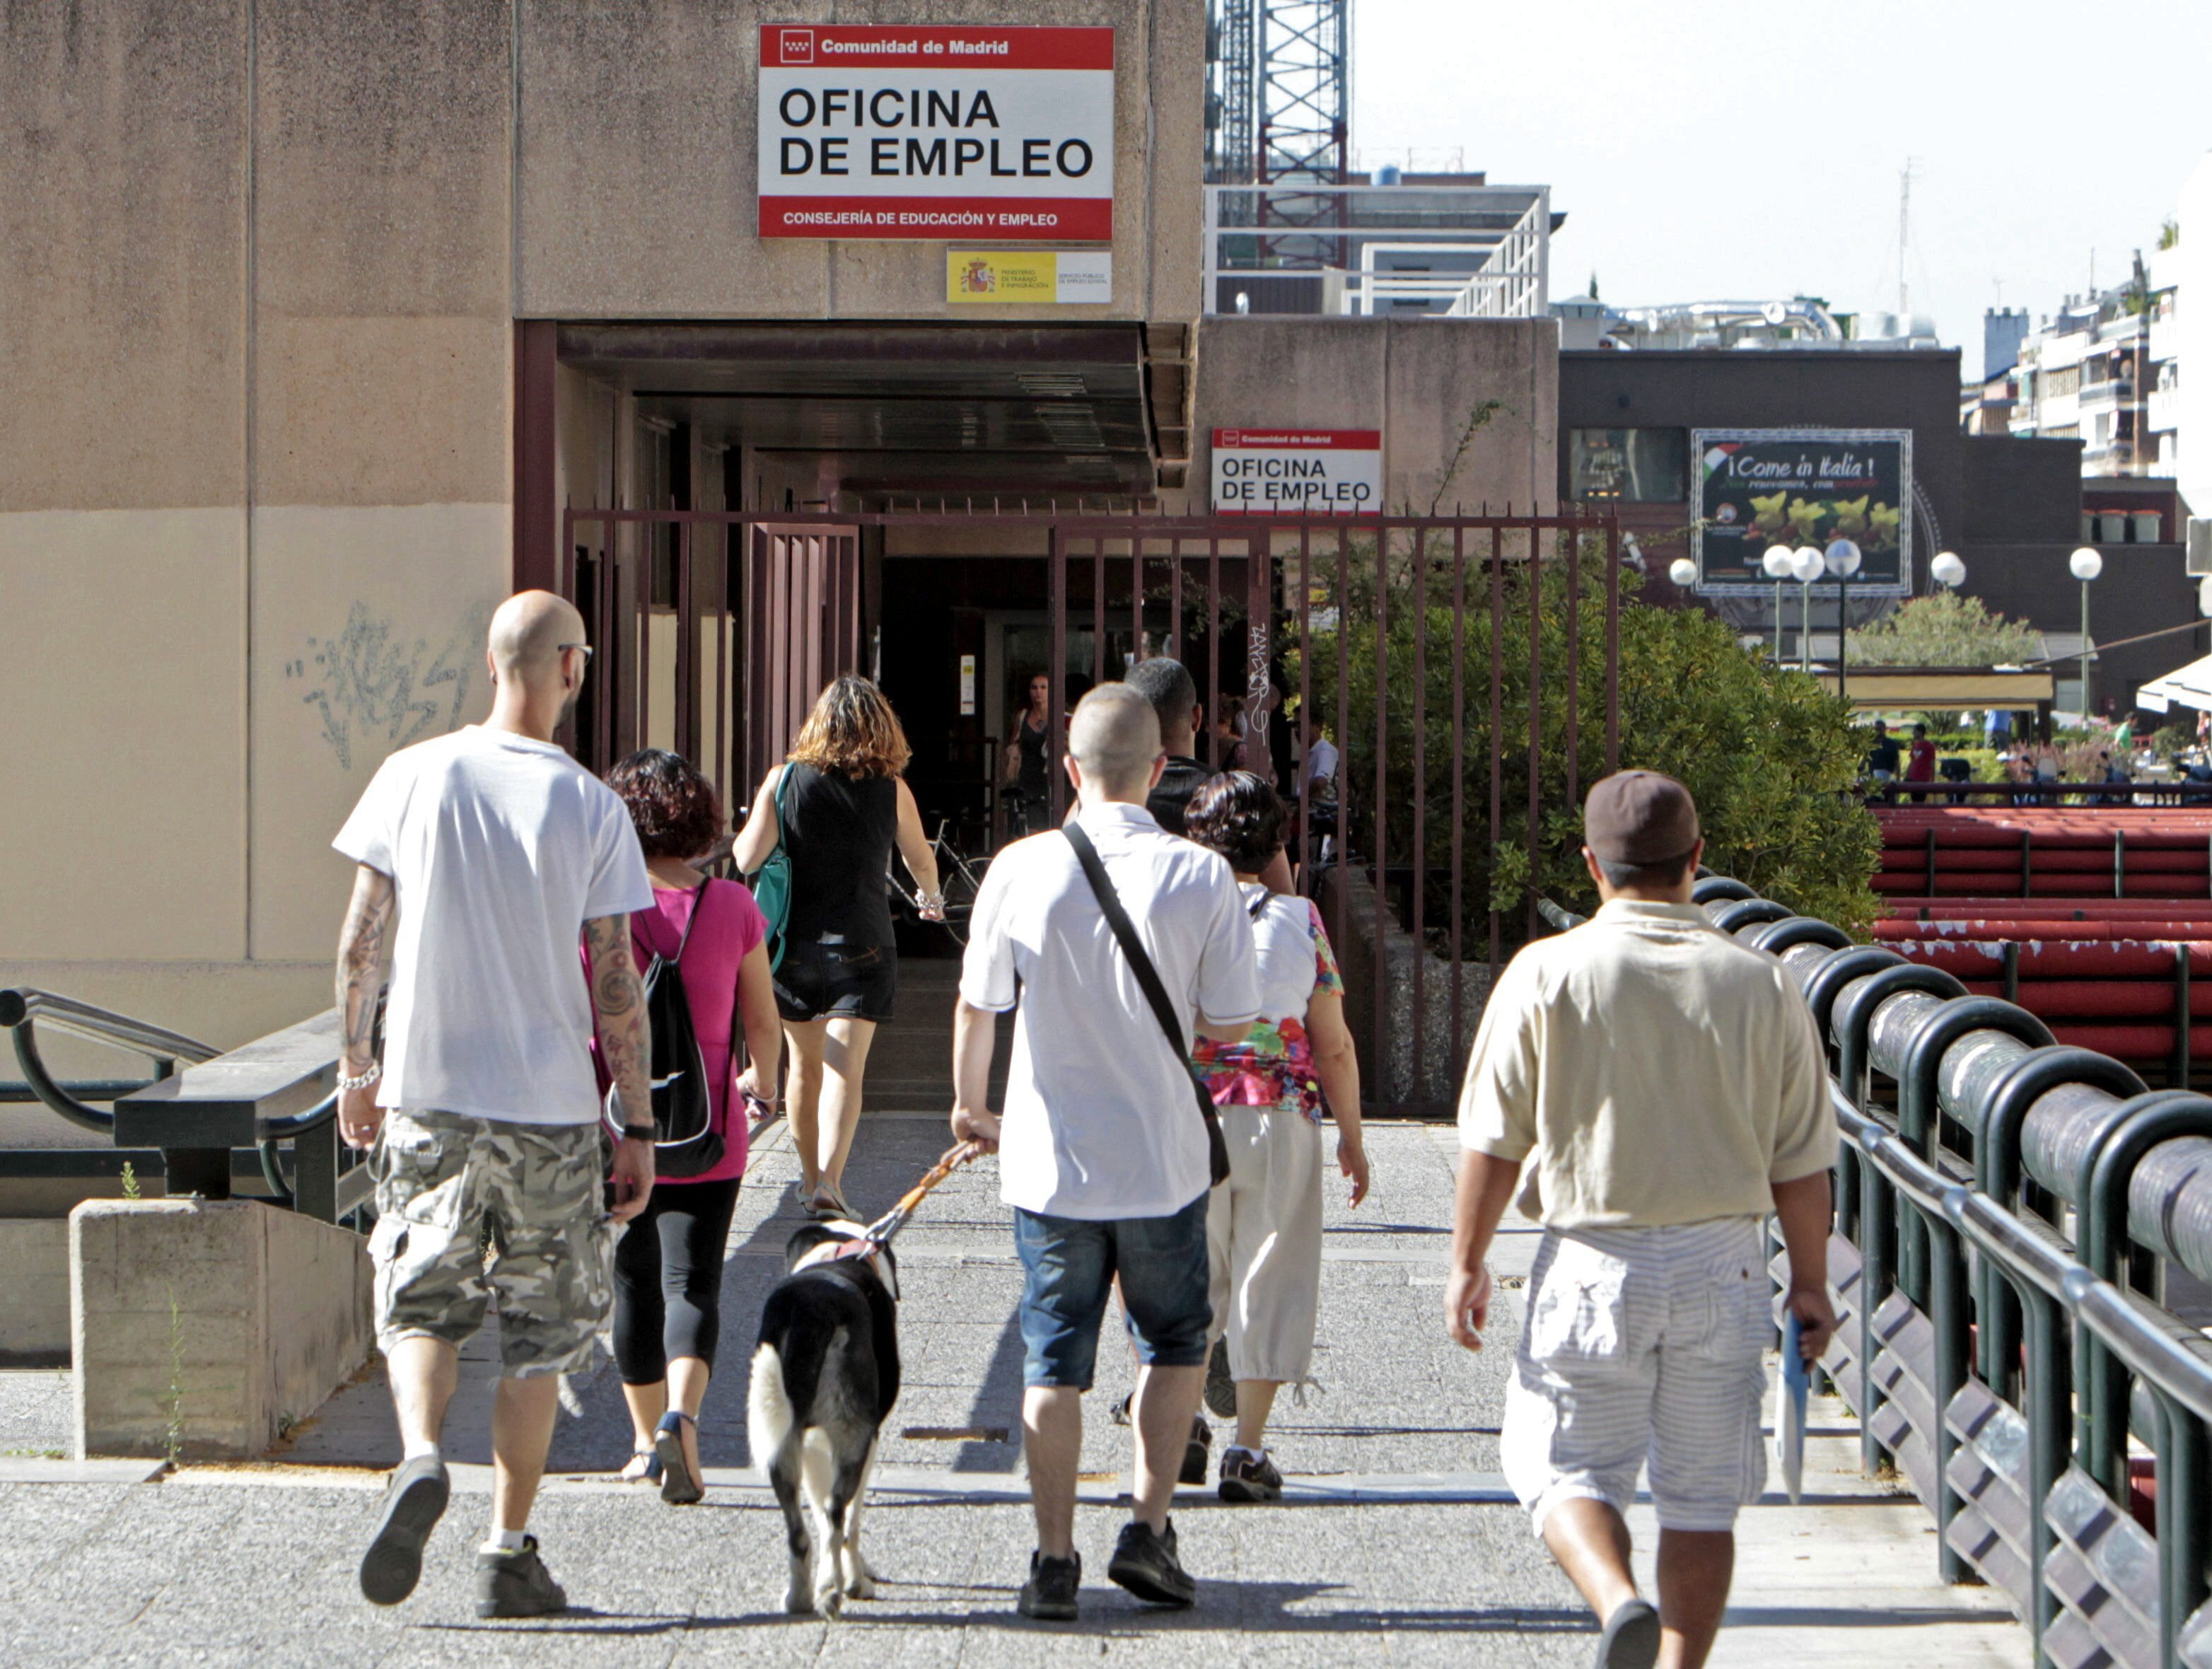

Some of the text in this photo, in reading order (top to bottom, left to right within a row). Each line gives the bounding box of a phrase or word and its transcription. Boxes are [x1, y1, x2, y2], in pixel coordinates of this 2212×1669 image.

[821, 39, 1008, 54] Comunidad de Madrid
[779, 88, 1000, 128] OFICINA
[781, 137, 1093, 178] DE EMPLEO
[783, 210, 1058, 226] CONSEJERÍA DE EDUCACIÓN Y EMPLEO
[1241, 435, 1288, 443] Comunidad
[1222, 458, 1326, 478] OFICINA
[1796, 454, 1812, 477] in
[1819, 452, 1862, 477] Italia
[1222, 481, 1370, 501] DE EMPLEO
